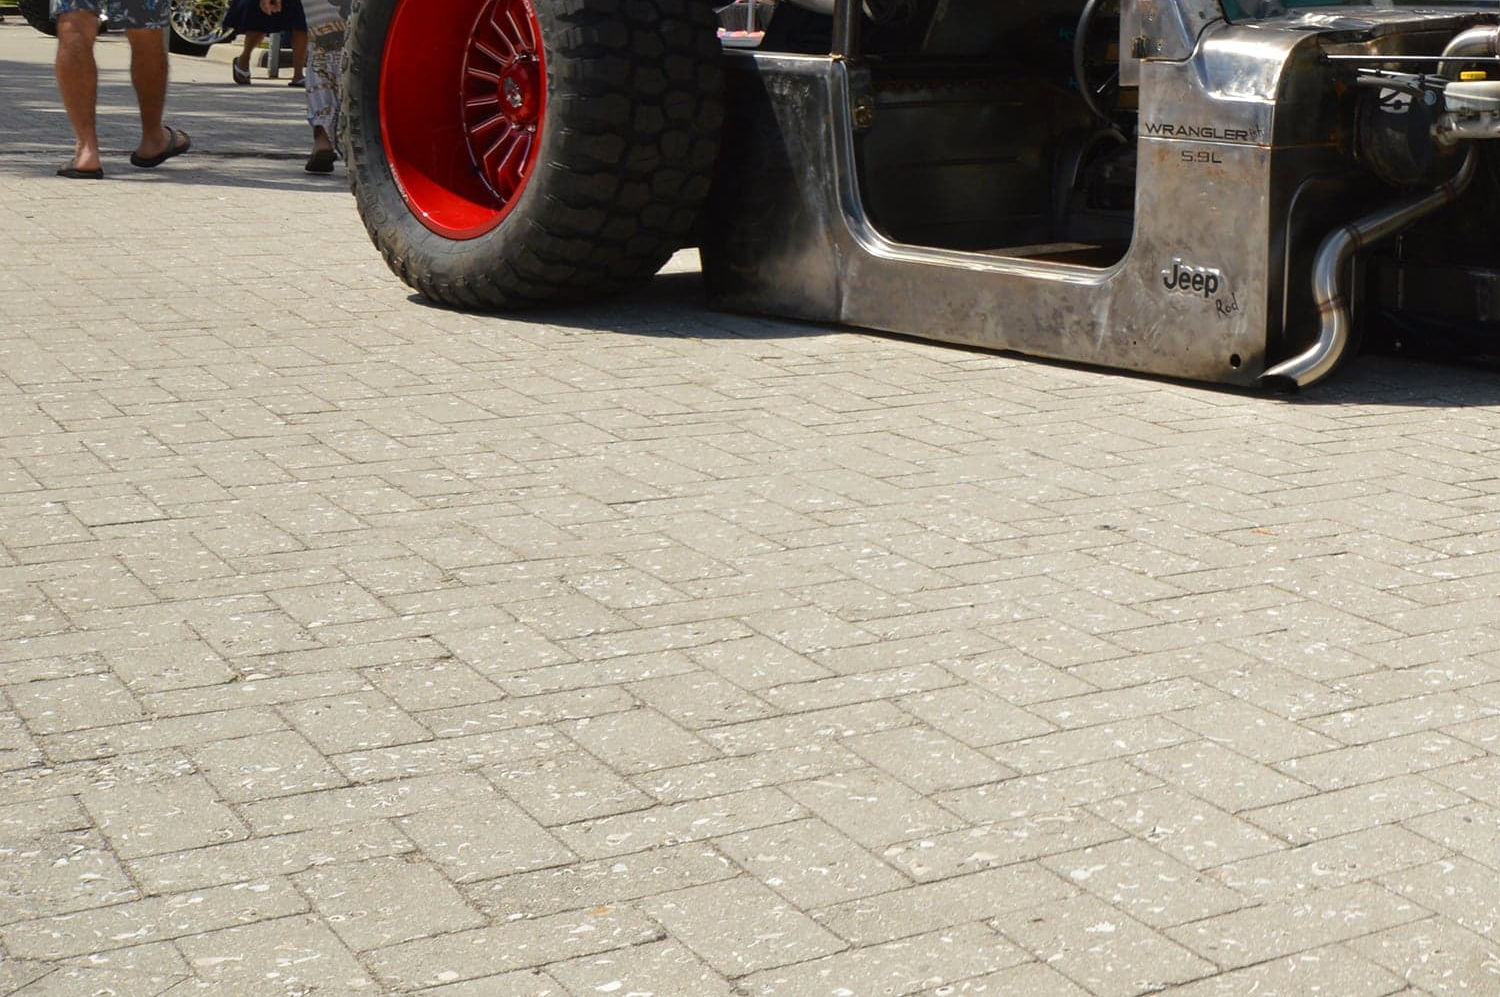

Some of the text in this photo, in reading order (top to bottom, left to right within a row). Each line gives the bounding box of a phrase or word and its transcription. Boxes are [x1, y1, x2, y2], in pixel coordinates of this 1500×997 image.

[1144, 122, 1248, 141] WRANGLER
[1162, 262, 1219, 299] Jeep
[1215, 291, 1240, 319] Rod
